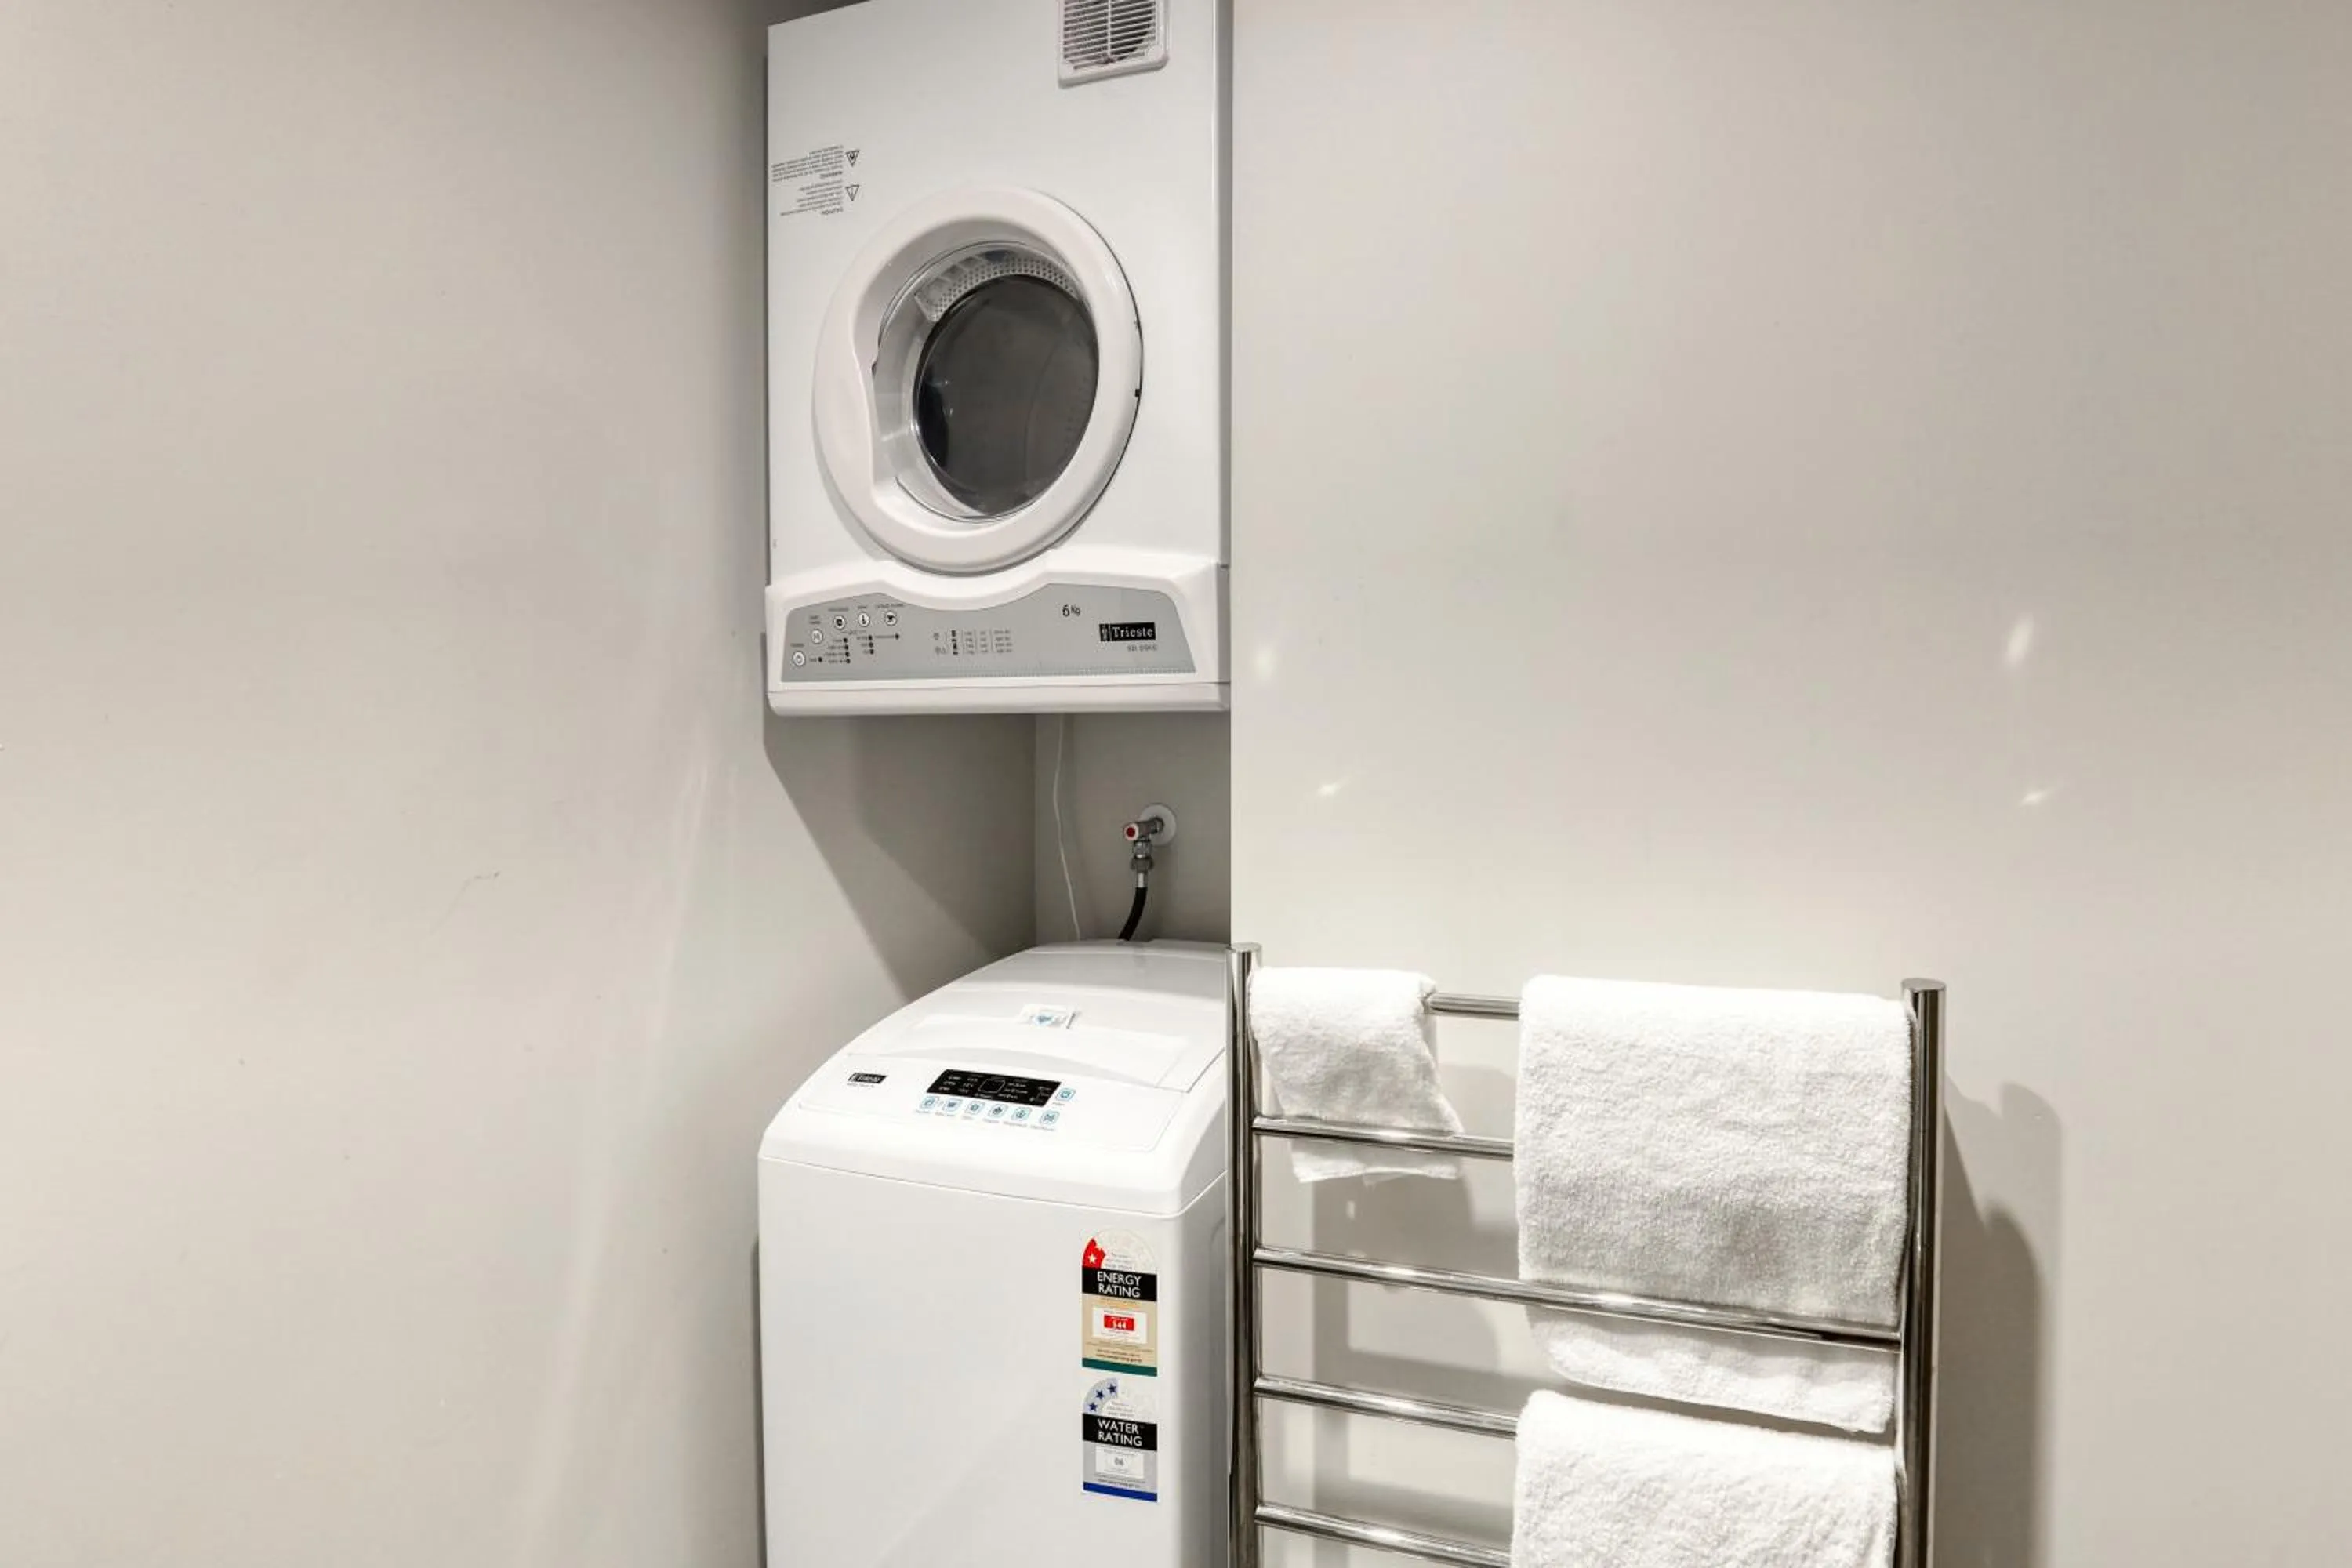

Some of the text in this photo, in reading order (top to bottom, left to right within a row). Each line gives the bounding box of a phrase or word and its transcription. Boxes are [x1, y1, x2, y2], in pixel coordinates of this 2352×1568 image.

[1112, 626, 1154, 638] Trieste
[1097, 1271, 1142, 1287] ENERGY
[1098, 1284, 1141, 1298] RATING
[1097, 1418, 1139, 1435] WATER
[1098, 1432, 1142, 1446] RATING
